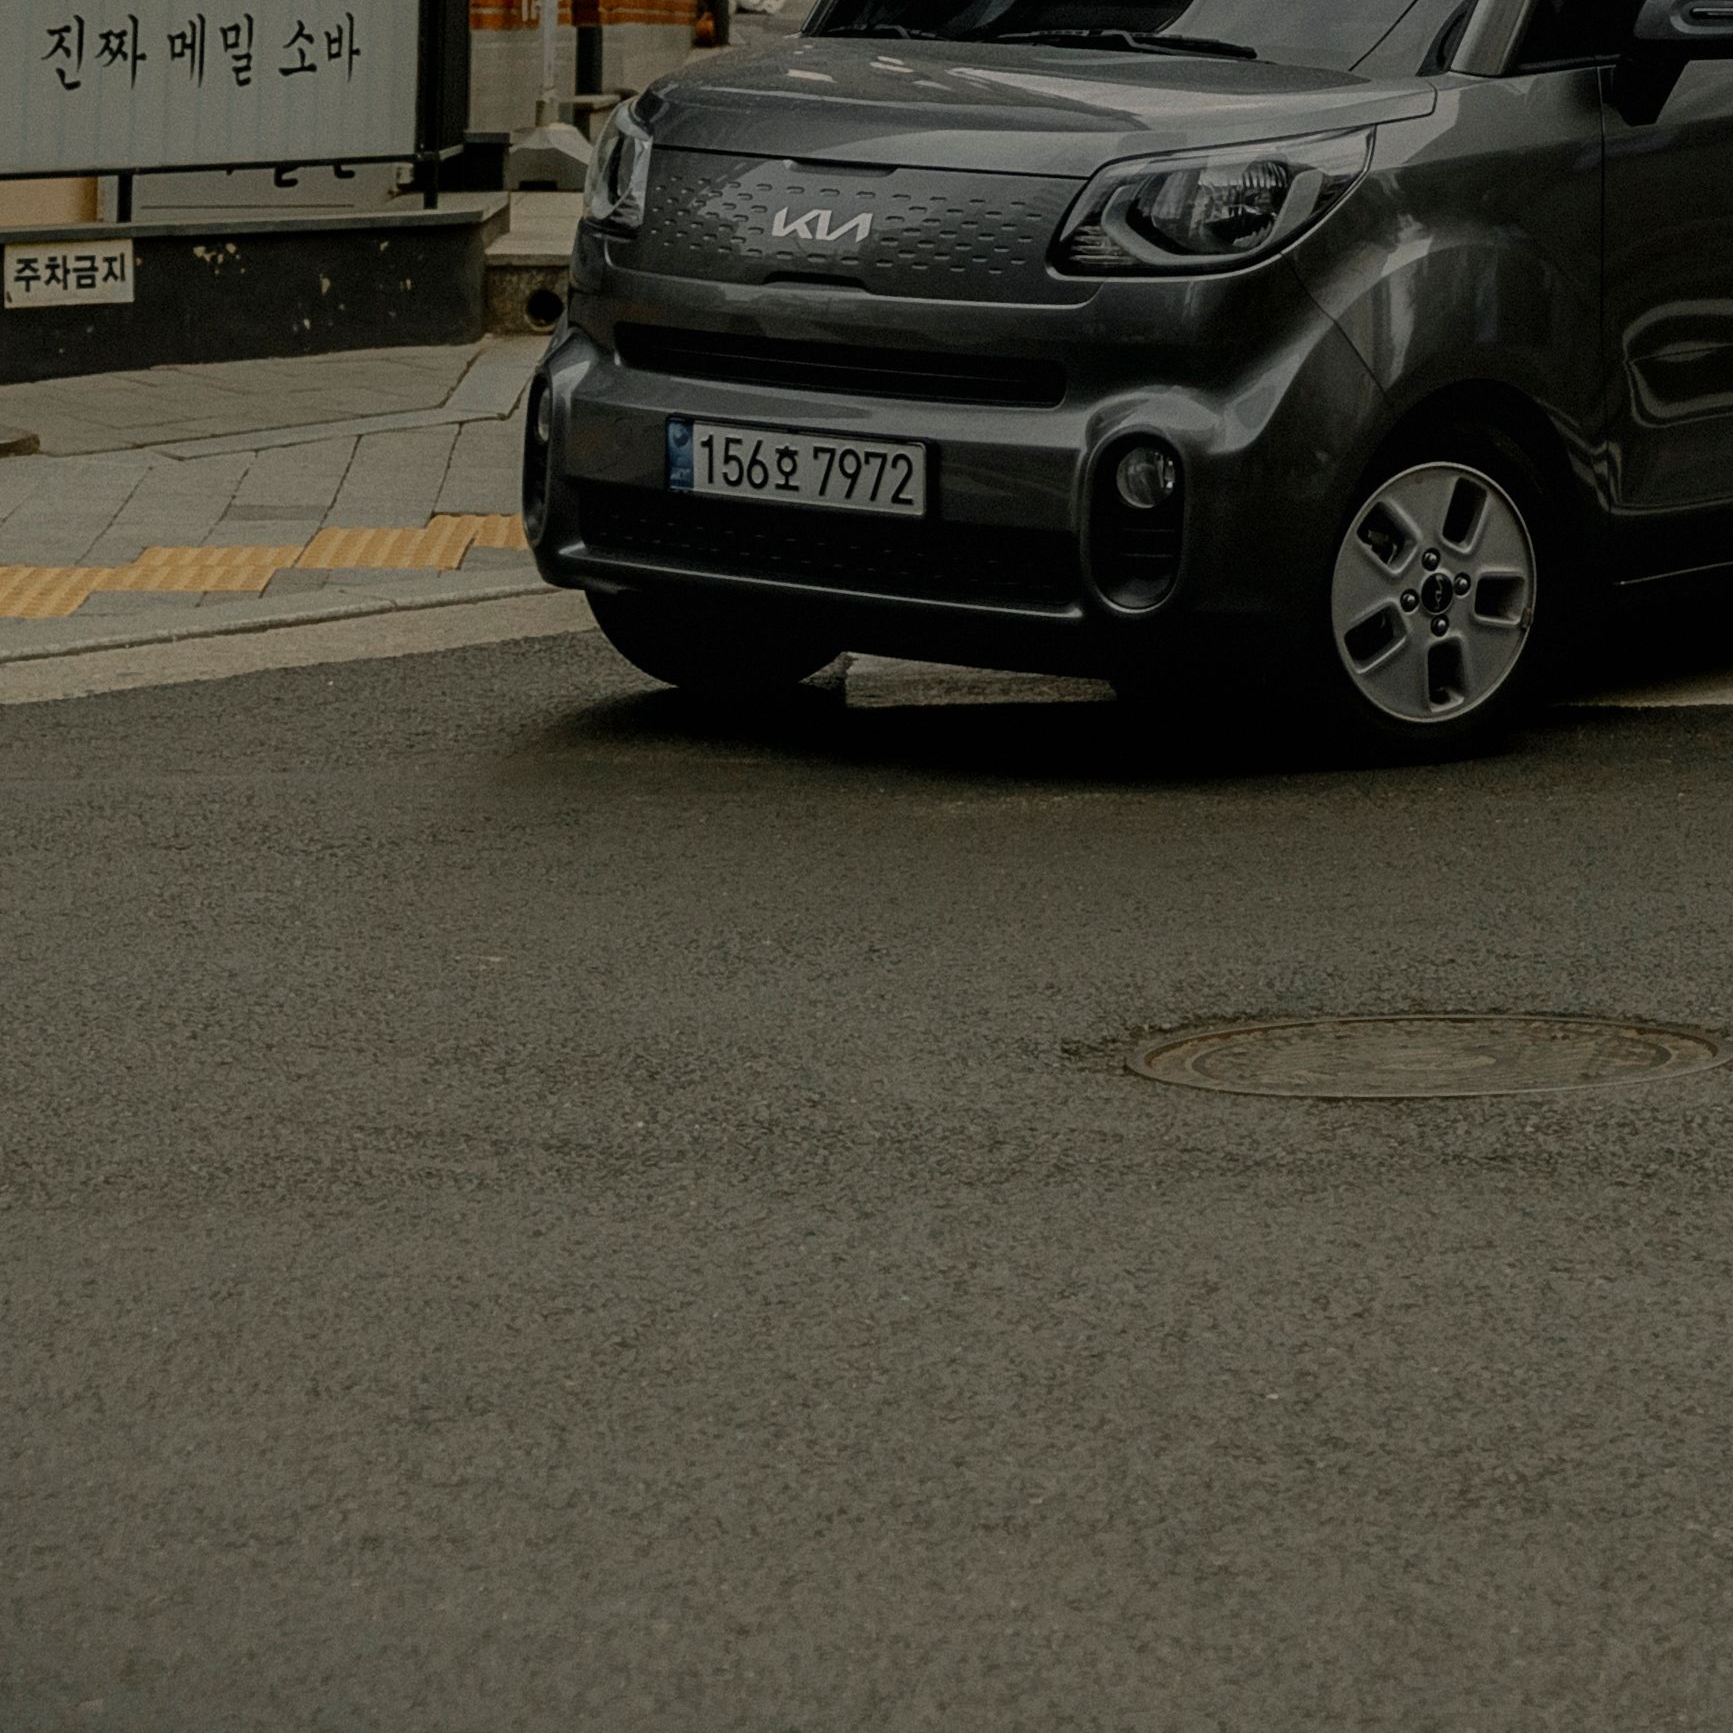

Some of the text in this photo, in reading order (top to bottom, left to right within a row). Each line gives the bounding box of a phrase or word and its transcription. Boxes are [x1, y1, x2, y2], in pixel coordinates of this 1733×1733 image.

[41, 11, 361, 91] 진짜 메밀 소바
[13, 252, 127, 292] 주차금지
[701, 434, 914, 506] 156호 7972
